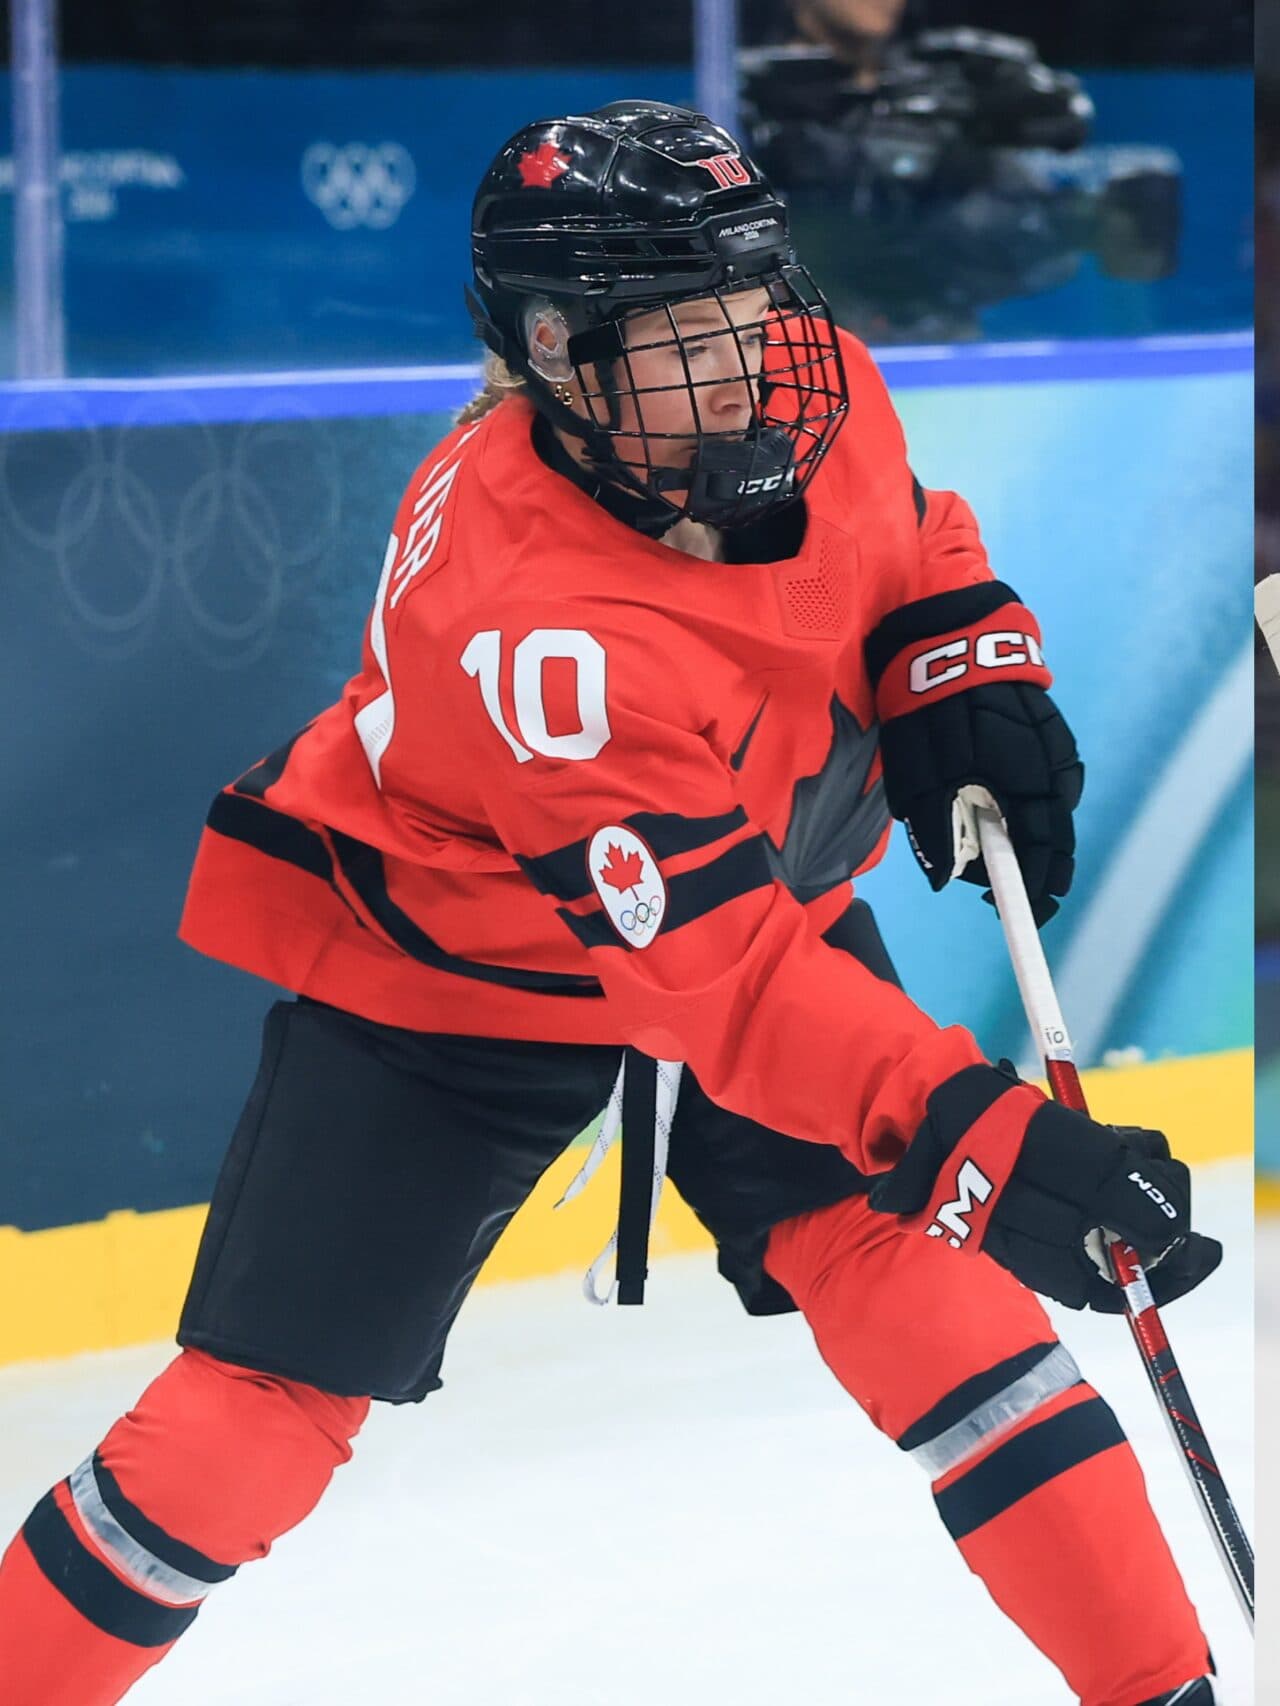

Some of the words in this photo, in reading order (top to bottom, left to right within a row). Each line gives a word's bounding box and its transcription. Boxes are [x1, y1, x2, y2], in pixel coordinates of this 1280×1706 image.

[696, 153, 751, 191] 10
[459, 628, 612, 764] 10
[1127, 1171, 1178, 1220] CCM
